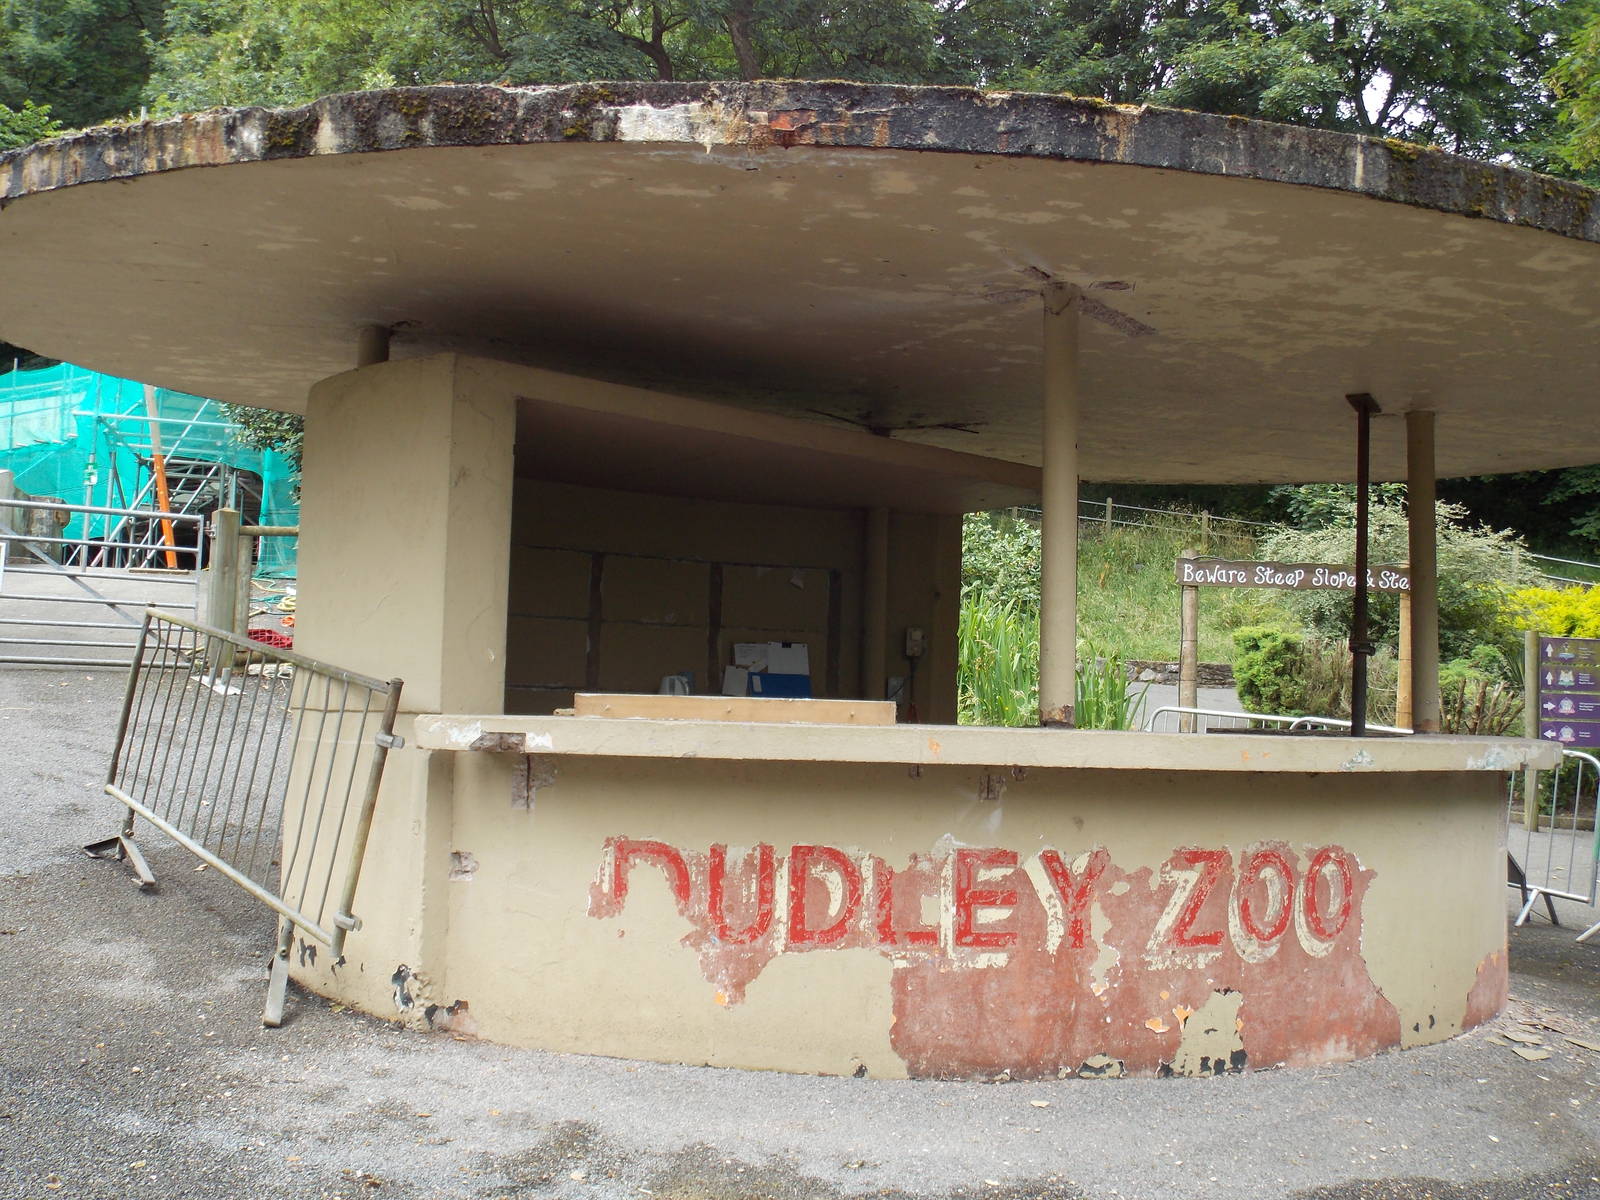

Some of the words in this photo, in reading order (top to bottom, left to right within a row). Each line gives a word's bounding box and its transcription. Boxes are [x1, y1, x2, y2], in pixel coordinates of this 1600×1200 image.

[1182, 563, 1247, 584] Beware
[1254, 565, 1304, 587] Steep
[1379, 570, 1411, 591] Ste
[1146, 844, 1353, 964] ZOO
